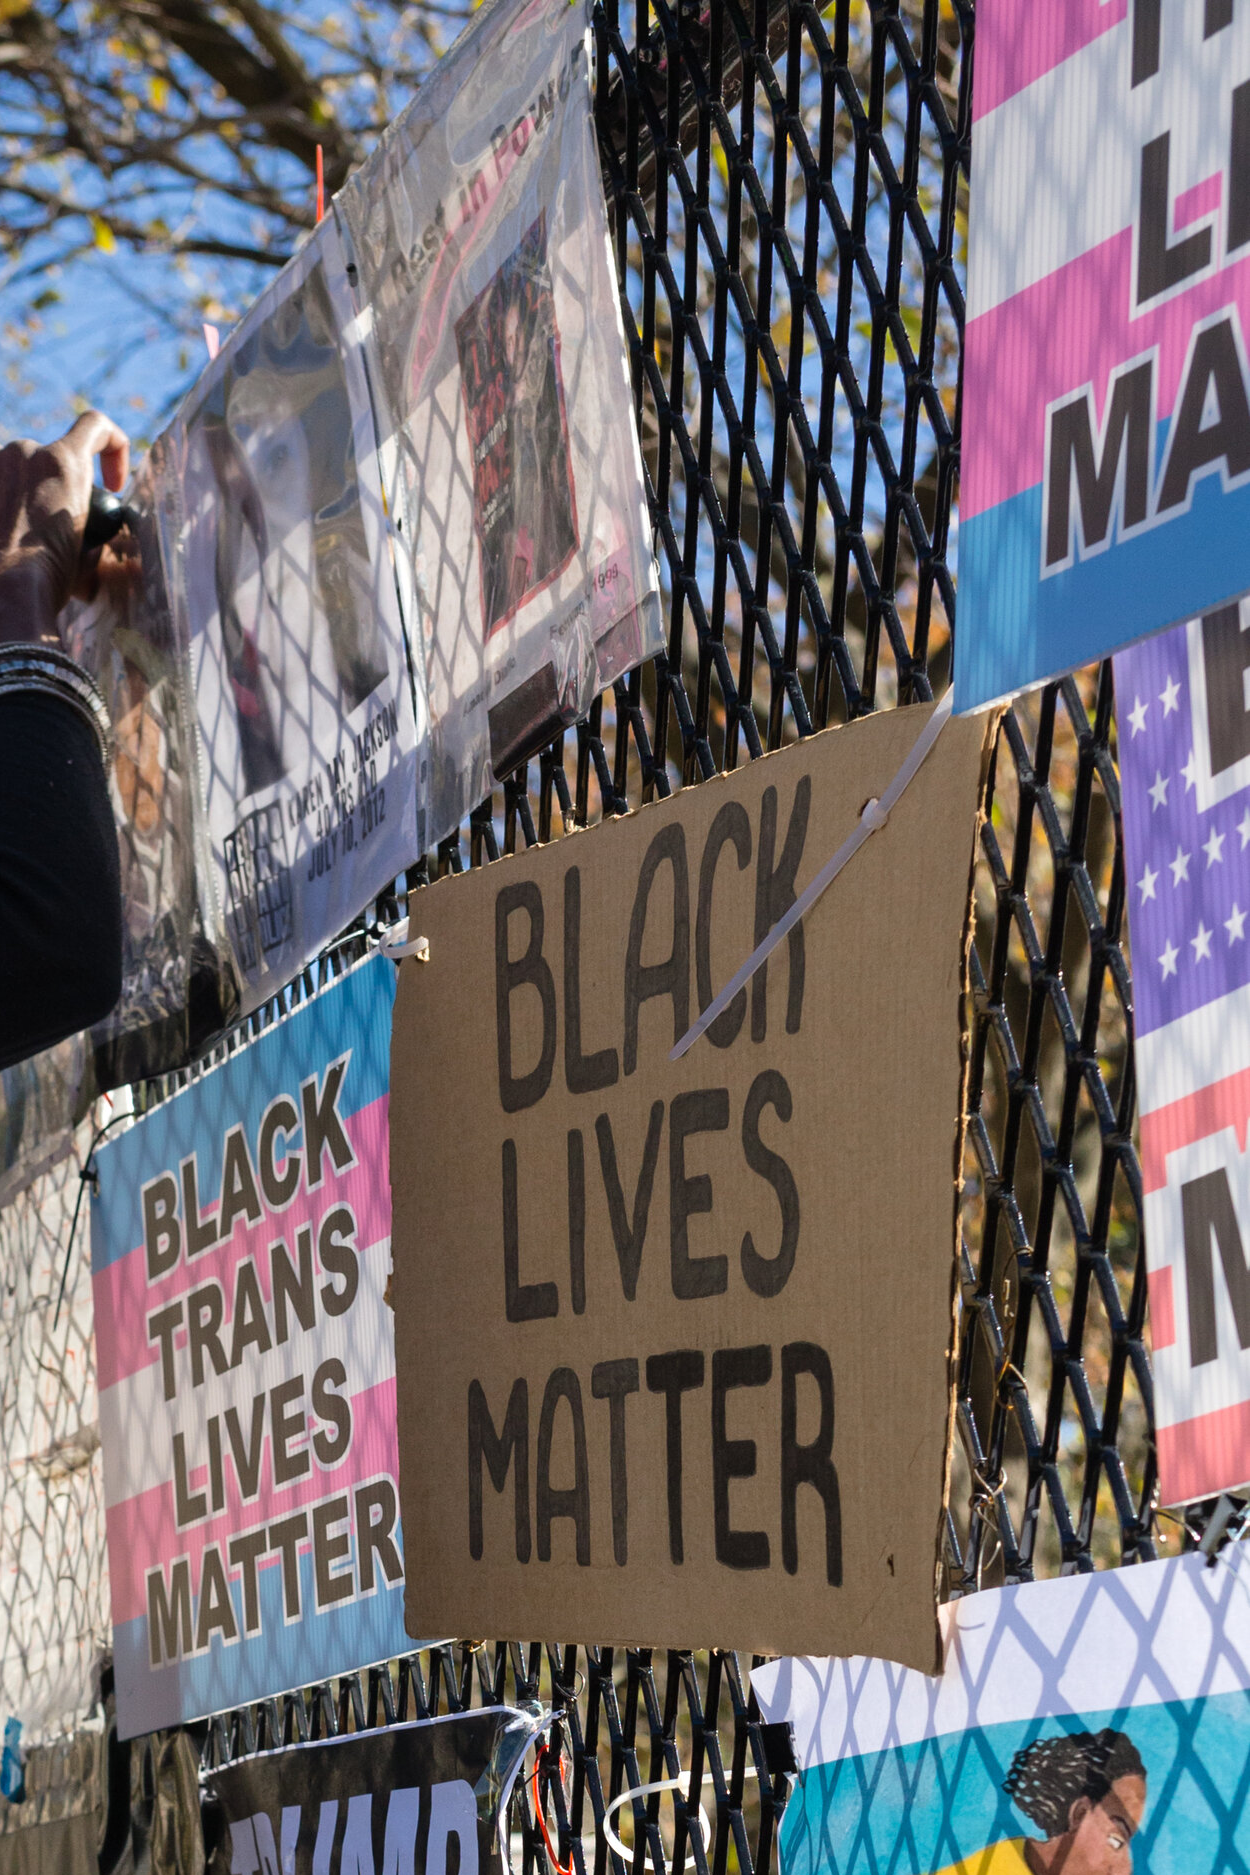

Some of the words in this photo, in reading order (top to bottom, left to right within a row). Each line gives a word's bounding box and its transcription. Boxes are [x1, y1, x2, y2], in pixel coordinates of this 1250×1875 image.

[352, 699, 399, 774] JACKSON
[494, 774, 813, 1114] BLACK
[147, 1063, 352, 1280] BLACK
[502, 1069, 800, 1323] LIVES
[148, 1211, 357, 1401] TRANS
[174, 1361, 351, 1528] LIVES
[467, 1341, 843, 1588] MATTER
[149, 1480, 404, 1663] MATTER
